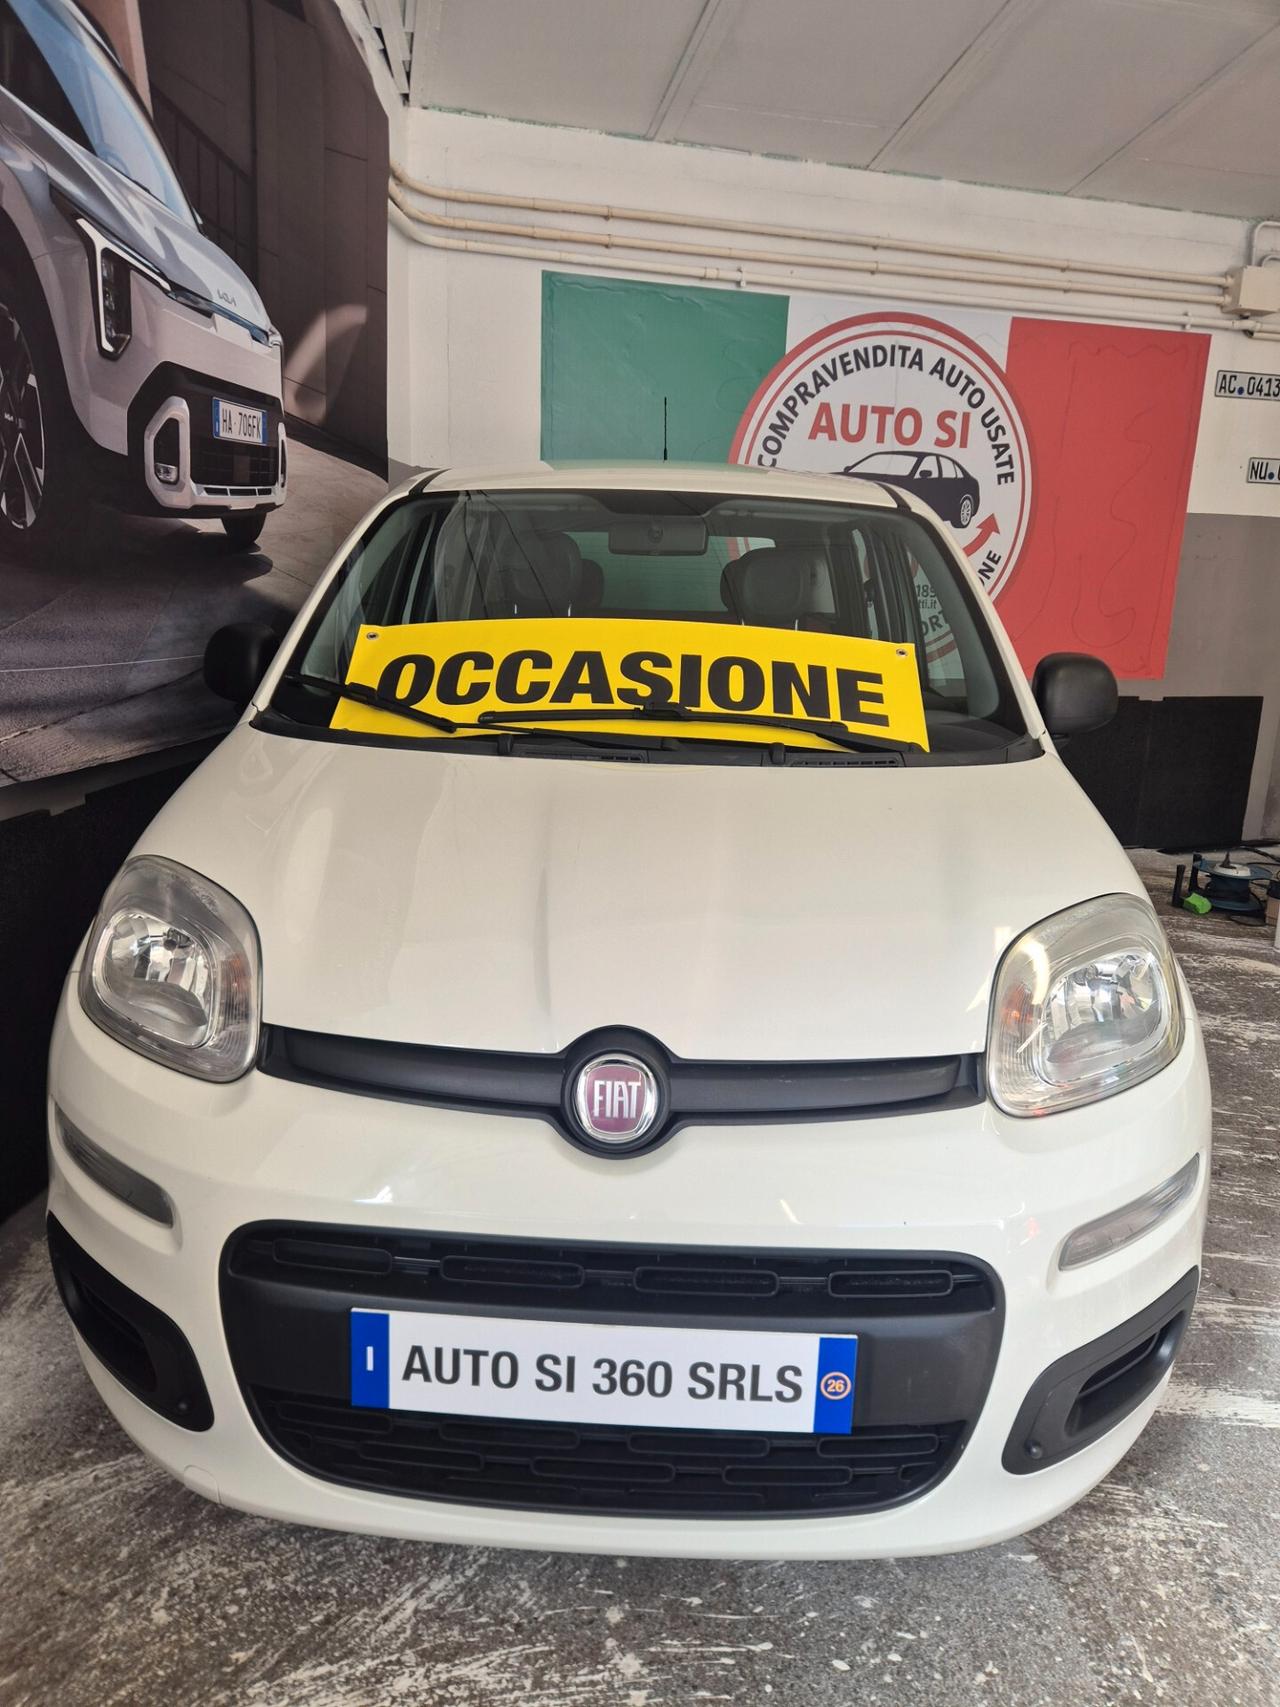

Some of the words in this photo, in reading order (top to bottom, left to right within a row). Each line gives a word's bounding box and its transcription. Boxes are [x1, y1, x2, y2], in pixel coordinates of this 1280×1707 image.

[757, 344, 924, 467] COMPRAVENDITA
[928, 357, 986, 409] AUTO
[980, 407, 1015, 486] USATE
[808, 402, 923, 446] AUTO
[934, 410, 971, 449] SI
[977, 549, 1002, 587] NE
[376, 650, 890, 728] OCCASIONE
[593, 1080, 642, 1119] FIAT
[402, 1345, 519, 1389] AUTO
[535, 1353, 576, 1393] SI
[592, 1357, 673, 1399] 360
[687, 1361, 803, 1404] SRLS
[826, 1378, 845, 1394] 26
